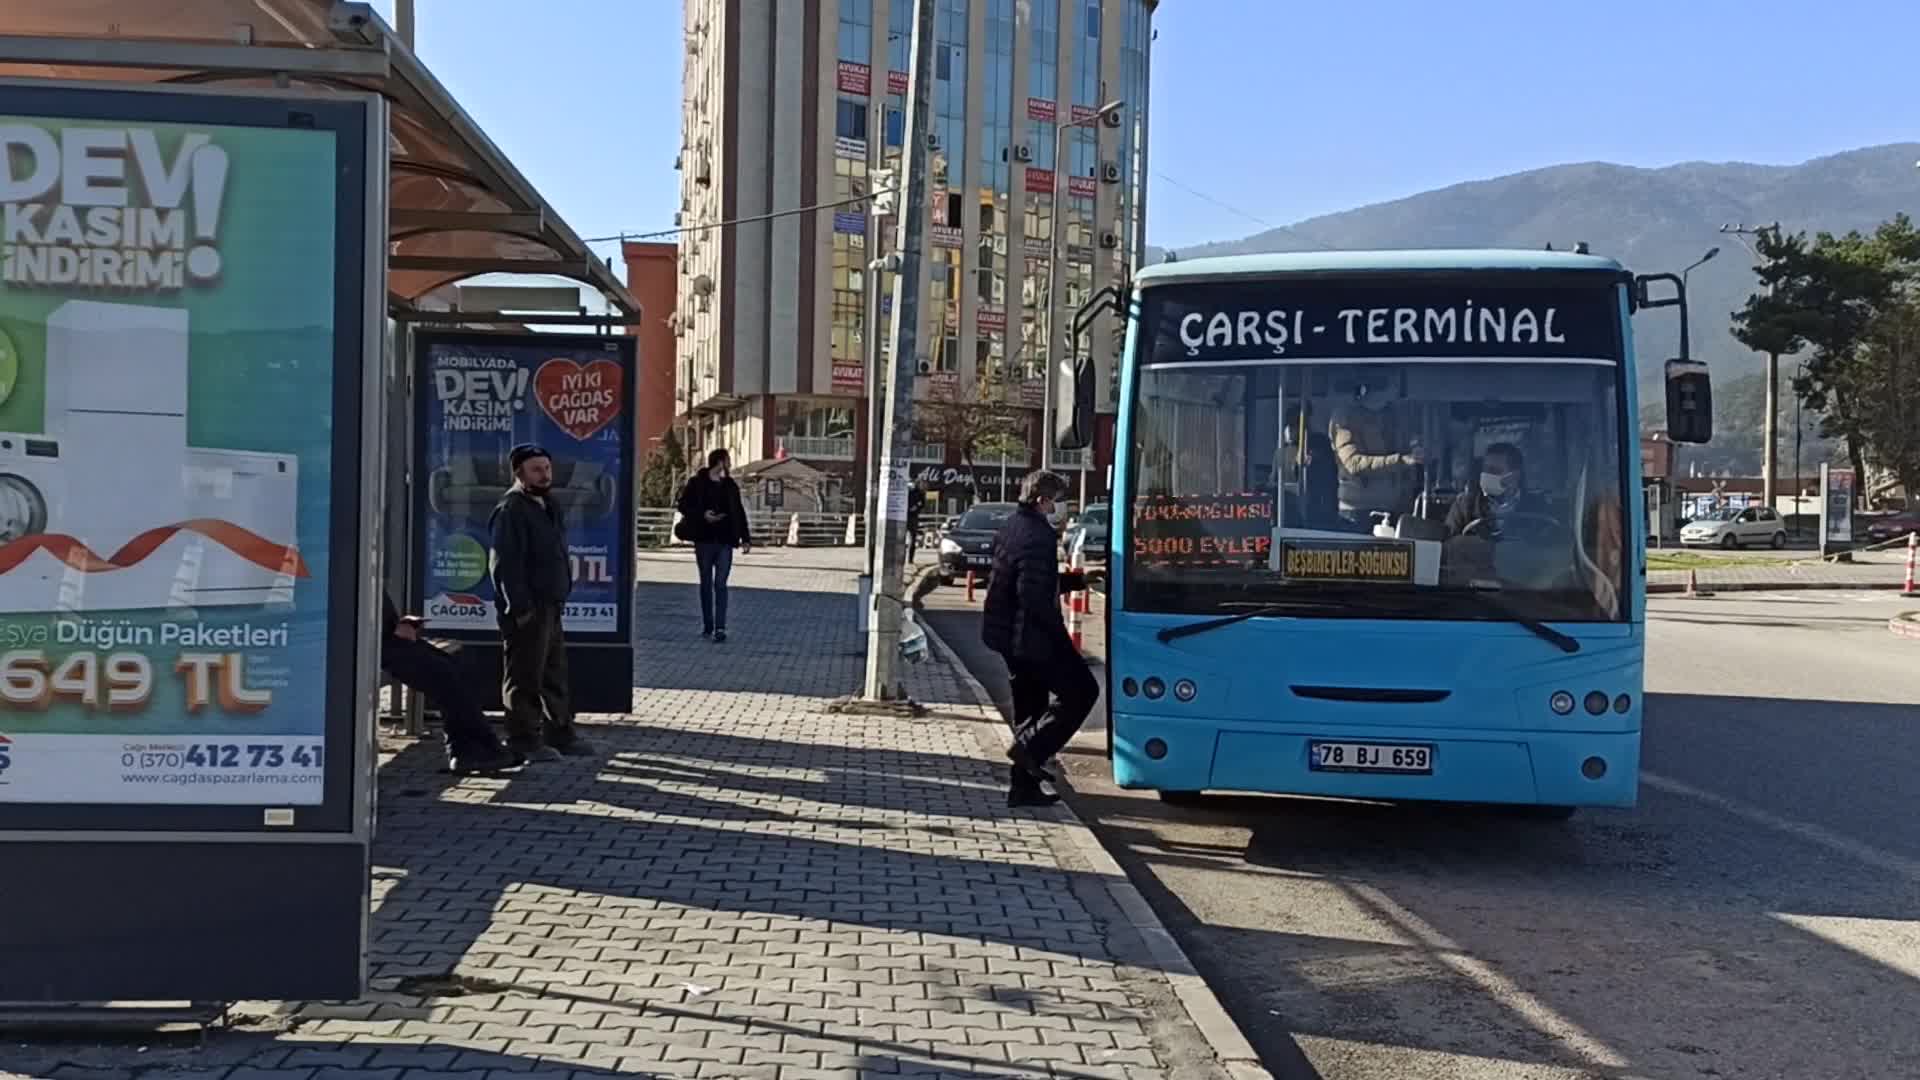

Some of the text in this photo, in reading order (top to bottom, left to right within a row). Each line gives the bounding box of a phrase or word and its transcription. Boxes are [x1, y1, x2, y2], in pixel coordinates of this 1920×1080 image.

[839, 62, 870, 75] AVUKAT
[4, 204, 185, 248] KASIM
[1179, 299, 1567, 357] ÇARŞI - TERMİNAL
[832, 367, 863, 377] AVUKAT
[434, 368, 530, 410] DEV!
[443, 400, 513, 416] KASIM
[549, 389, 614, 413] ÇAĞDAŞ
[563, 407, 599, 425] VAR
[1199, 535, 1271, 554] EVLER
[584, 556, 613, 582] TL
[582, 607, 597, 617] 73
[600, 608, 614, 617] 41
[56, 618, 154, 650] Düğün
[160, 622, 289, 648] Paketleri
[176, 653, 274, 710] TL
[248, 744, 284, 767] 73
[291, 745, 323, 767] 41
[1322, 746, 1344, 764] 78
[1357, 747, 1380, 766] BJ
[1392, 749, 1427, 767] 659
[121, 773, 322, 786] www.cagdaspazarlama.com
